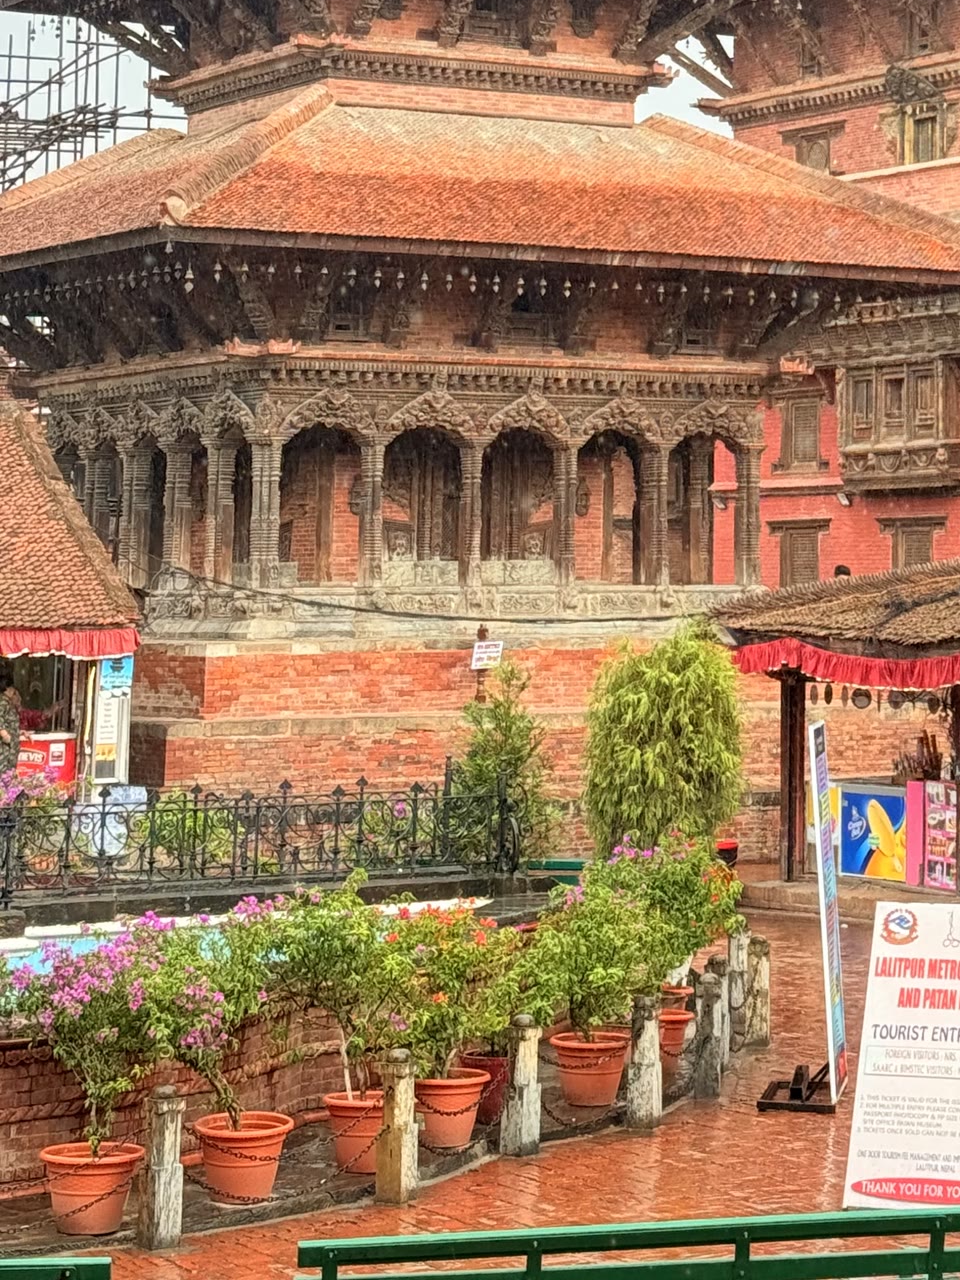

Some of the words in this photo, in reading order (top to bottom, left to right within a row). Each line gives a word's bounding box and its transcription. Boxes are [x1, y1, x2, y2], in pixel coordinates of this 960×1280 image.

[875, 957, 925, 978] LALITPUR
[898, 988, 920, 1008] AND
[923, 989, 956, 1010] PATAN
[872, 1024, 928, 1041] TOURIST
[885, 1049, 911, 1060] FOREIGN
[913, 1051, 939, 1061] VISITORS
[873, 1063, 893, 1072] SAARC
[900, 1064, 925, 1074] BIMSTEC
[927, 1065, 952, 1075] VISITORS
[861, 1181, 896, 1194] THANK
[899, 1183, 921, 1195] YOU
[924, 1184, 943, 1197] FOR
